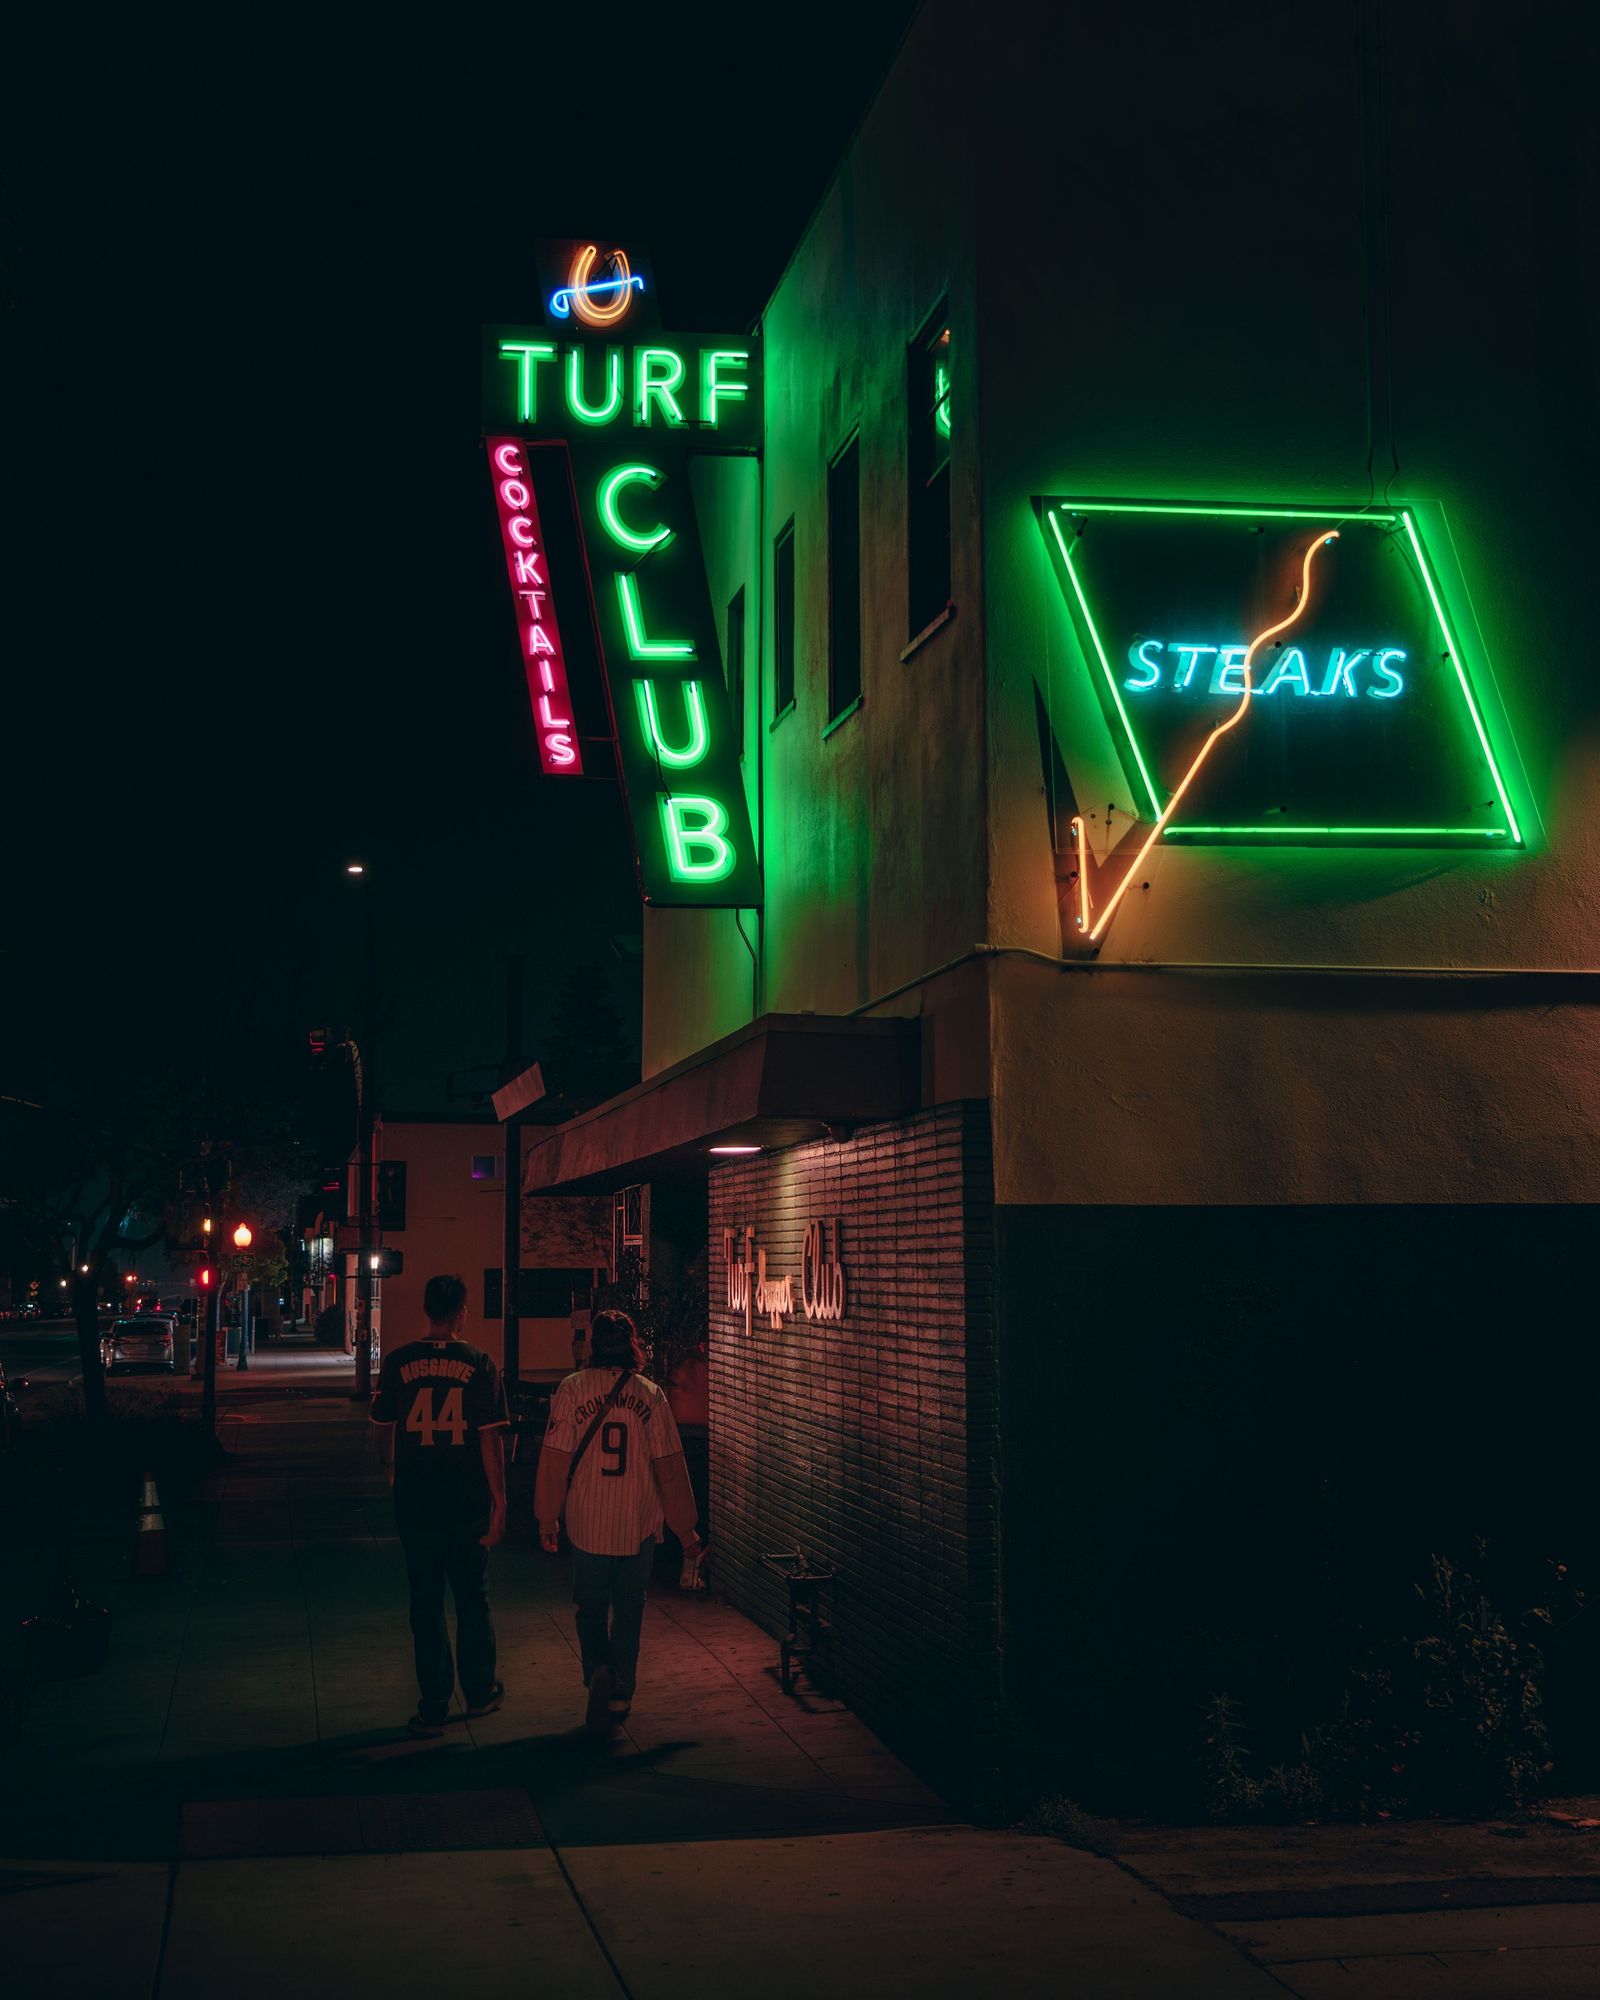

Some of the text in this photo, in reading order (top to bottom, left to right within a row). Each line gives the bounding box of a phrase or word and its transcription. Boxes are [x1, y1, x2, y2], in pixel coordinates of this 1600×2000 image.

[499, 339, 749, 430] TURF
[495, 444, 577, 767] COCKTAILS
[596, 462, 737, 884] CLUB
[1123, 638, 1407, 698] STEAKS
[723, 1225, 756, 1337] Turf
[802, 1217, 846, 1320] Club
[400, 1357, 476, 1384] MUSGROVE
[406, 1386, 468, 1447] 44
[575, 1393, 653, 1425] CRONWORTH
[601, 1422, 628, 1476] 9
